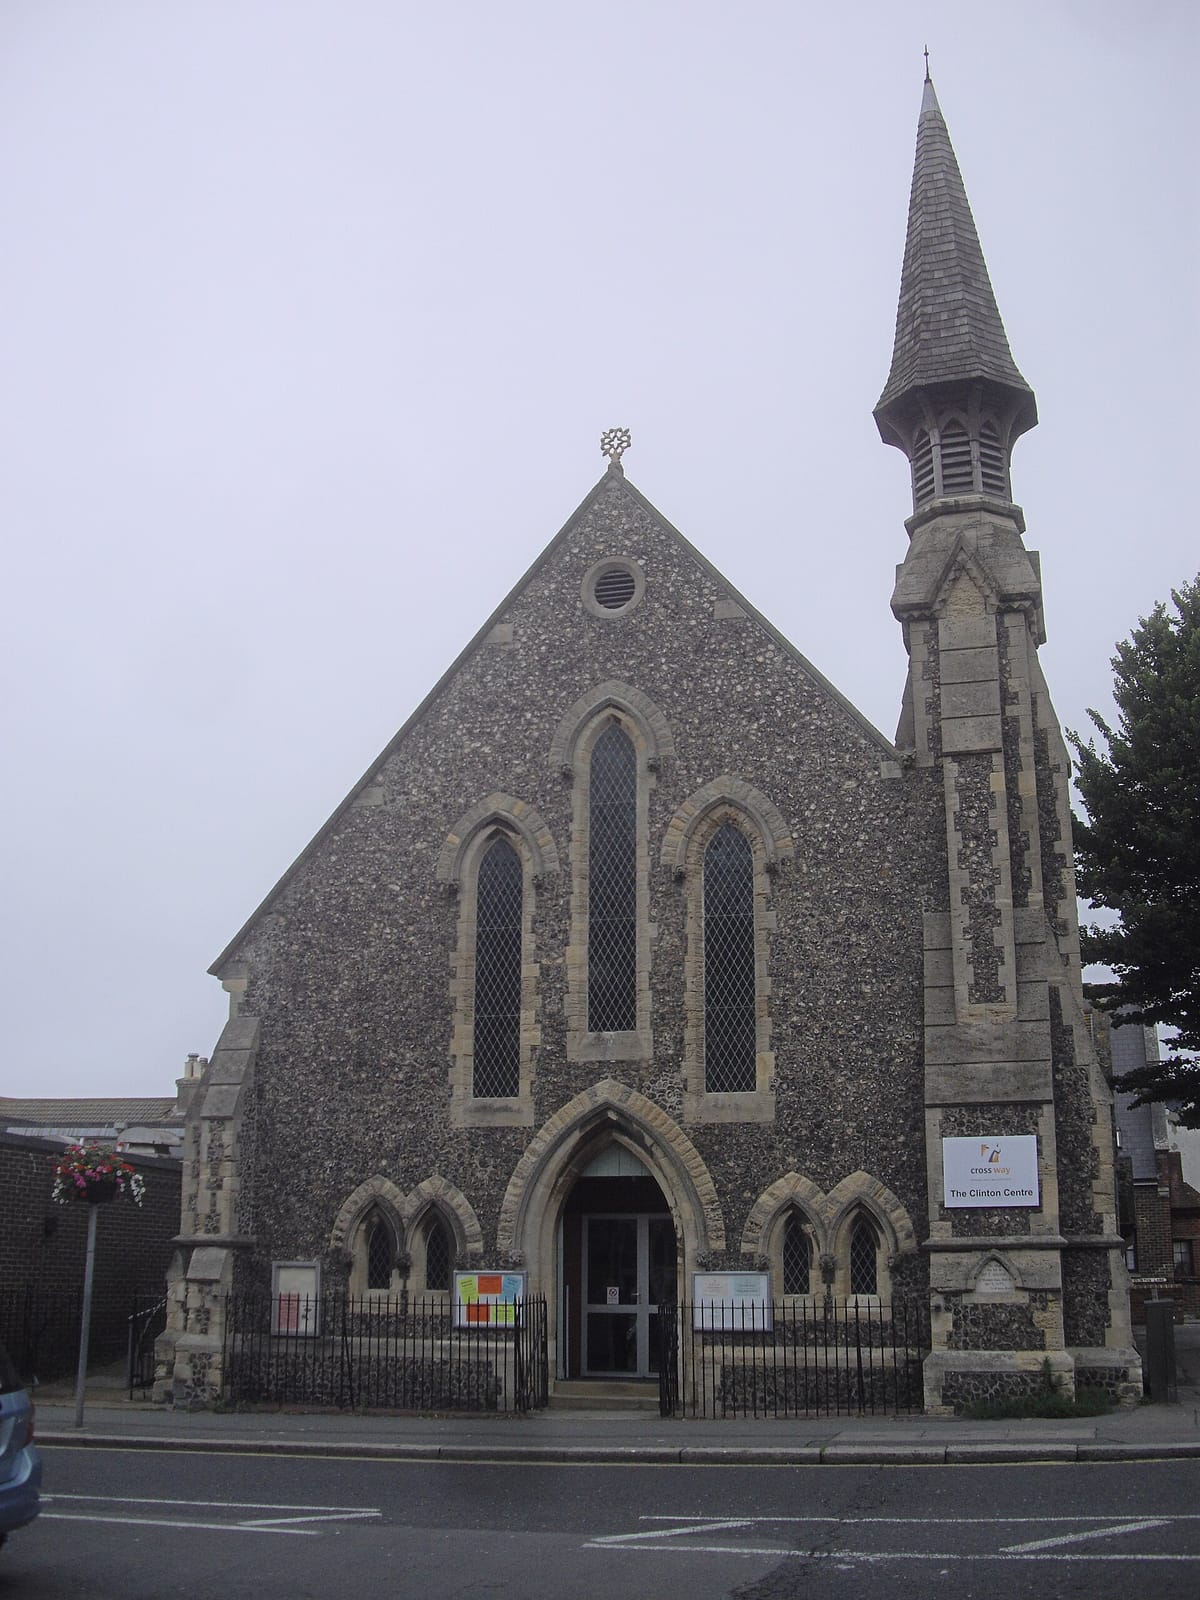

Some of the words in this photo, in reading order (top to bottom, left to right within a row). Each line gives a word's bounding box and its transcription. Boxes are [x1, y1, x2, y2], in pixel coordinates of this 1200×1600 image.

[993, 1167, 1011, 1175] way
[951, 1189, 967, 1198] The
[969, 1189, 1001, 1198] Clinton
[1003, 1188, 1033, 1197] Centre
